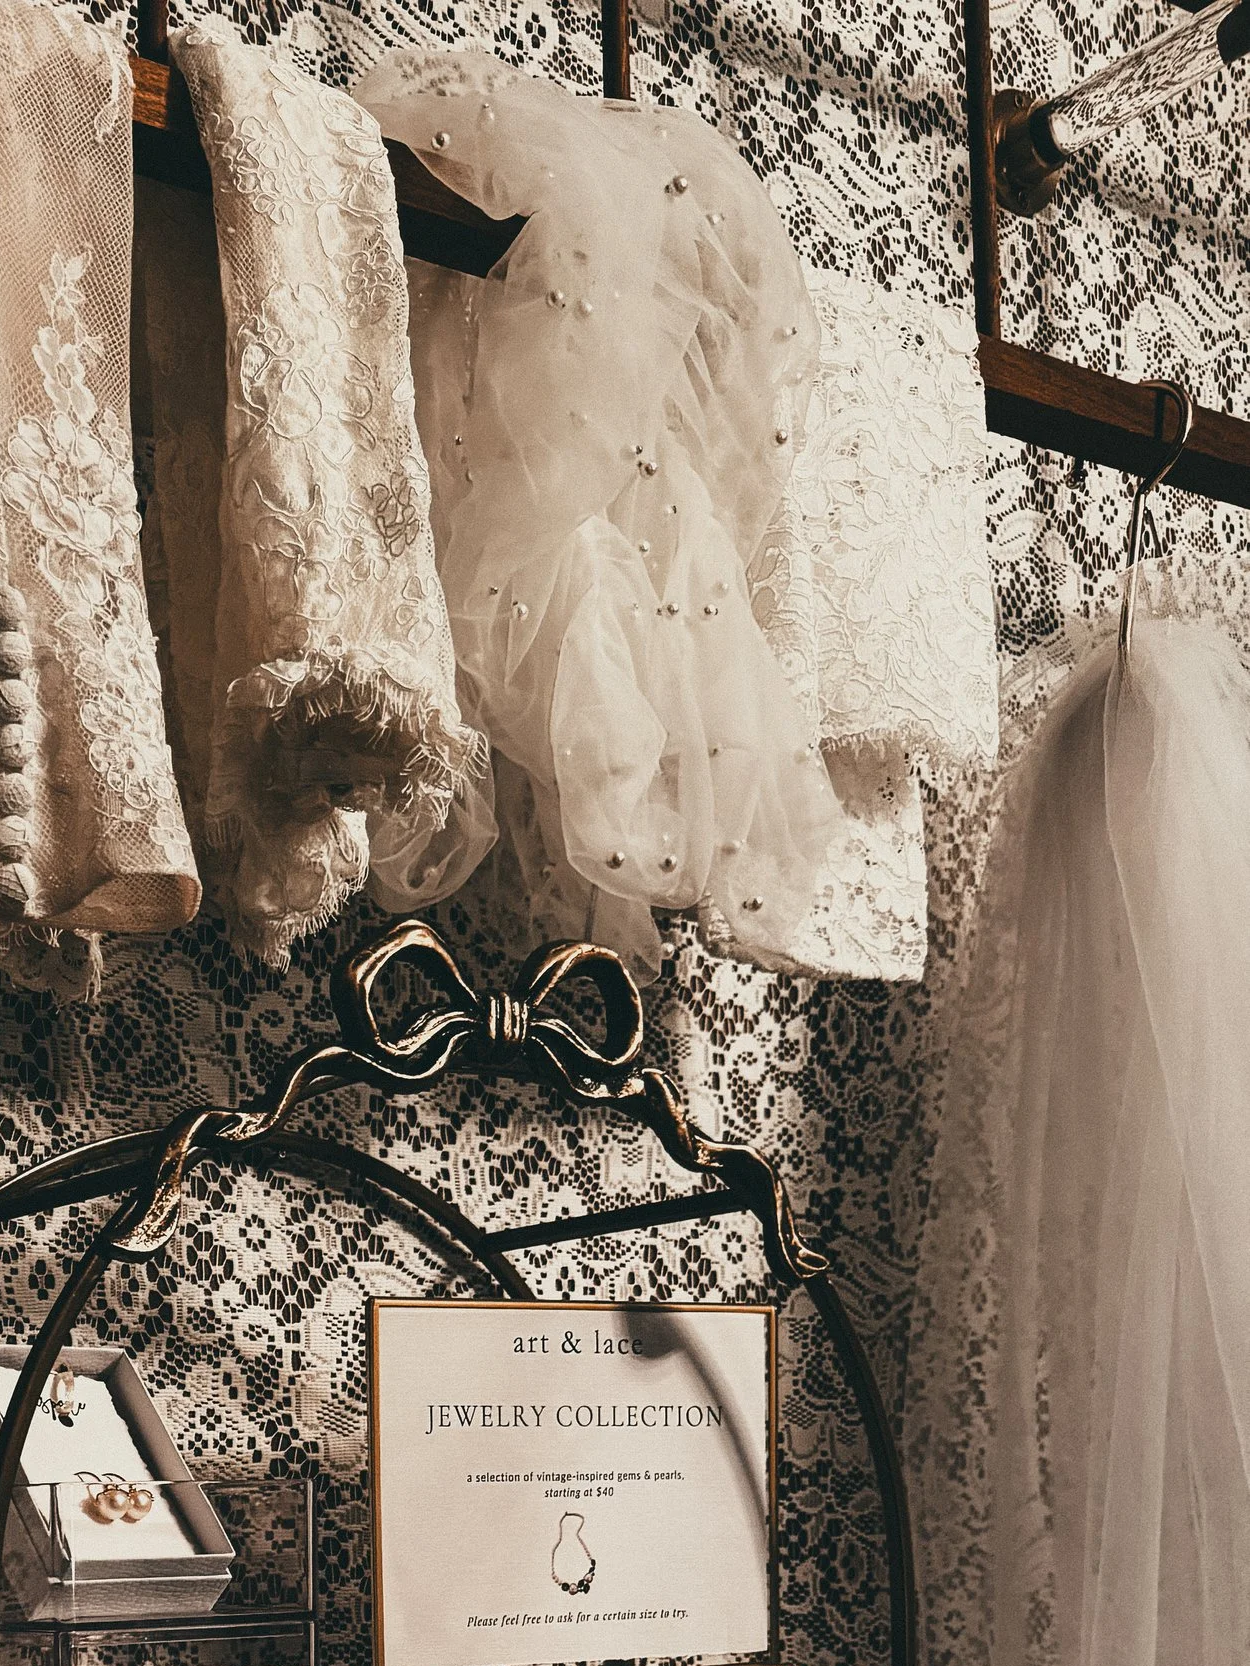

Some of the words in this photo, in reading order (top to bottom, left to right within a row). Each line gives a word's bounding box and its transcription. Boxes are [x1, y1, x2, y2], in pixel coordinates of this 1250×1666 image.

[513, 1334, 549, 1353] art
[561, 1330, 582, 1354] &
[594, 1329, 644, 1355] lace
[425, 1404, 546, 1435] JEWELRY
[556, 1404, 724, 1427] COLLECTION
[466, 1474, 472, 1482] a
[475, 1472, 520, 1483] selection
[523, 1471, 534, 1482] of
[536, 1470, 614, 1483] vintage-inspired
[617, 1472, 641, 1483] gems
[644, 1470, 651, 1480] &
[544, 1487, 581, 1499] starting
[583, 1487, 593, 1497] at
[596, 1486, 614, 1498] $40
[467, 1615, 499, 1628] Please
[500, 1614, 520, 1628] feel
[521, 1613, 542, 1627] free
[544, 1614, 554, 1624] to
[556, 1611, 573, 1623] ask
[576, 1611, 591, 1624] for
[593, 1613, 599, 1621] a
[602, 1609, 637, 1621] certain
[639, 1608, 658, 1619] size
[660, 1609, 670, 1619] to
[672, 1608, 689, 1620] try.
